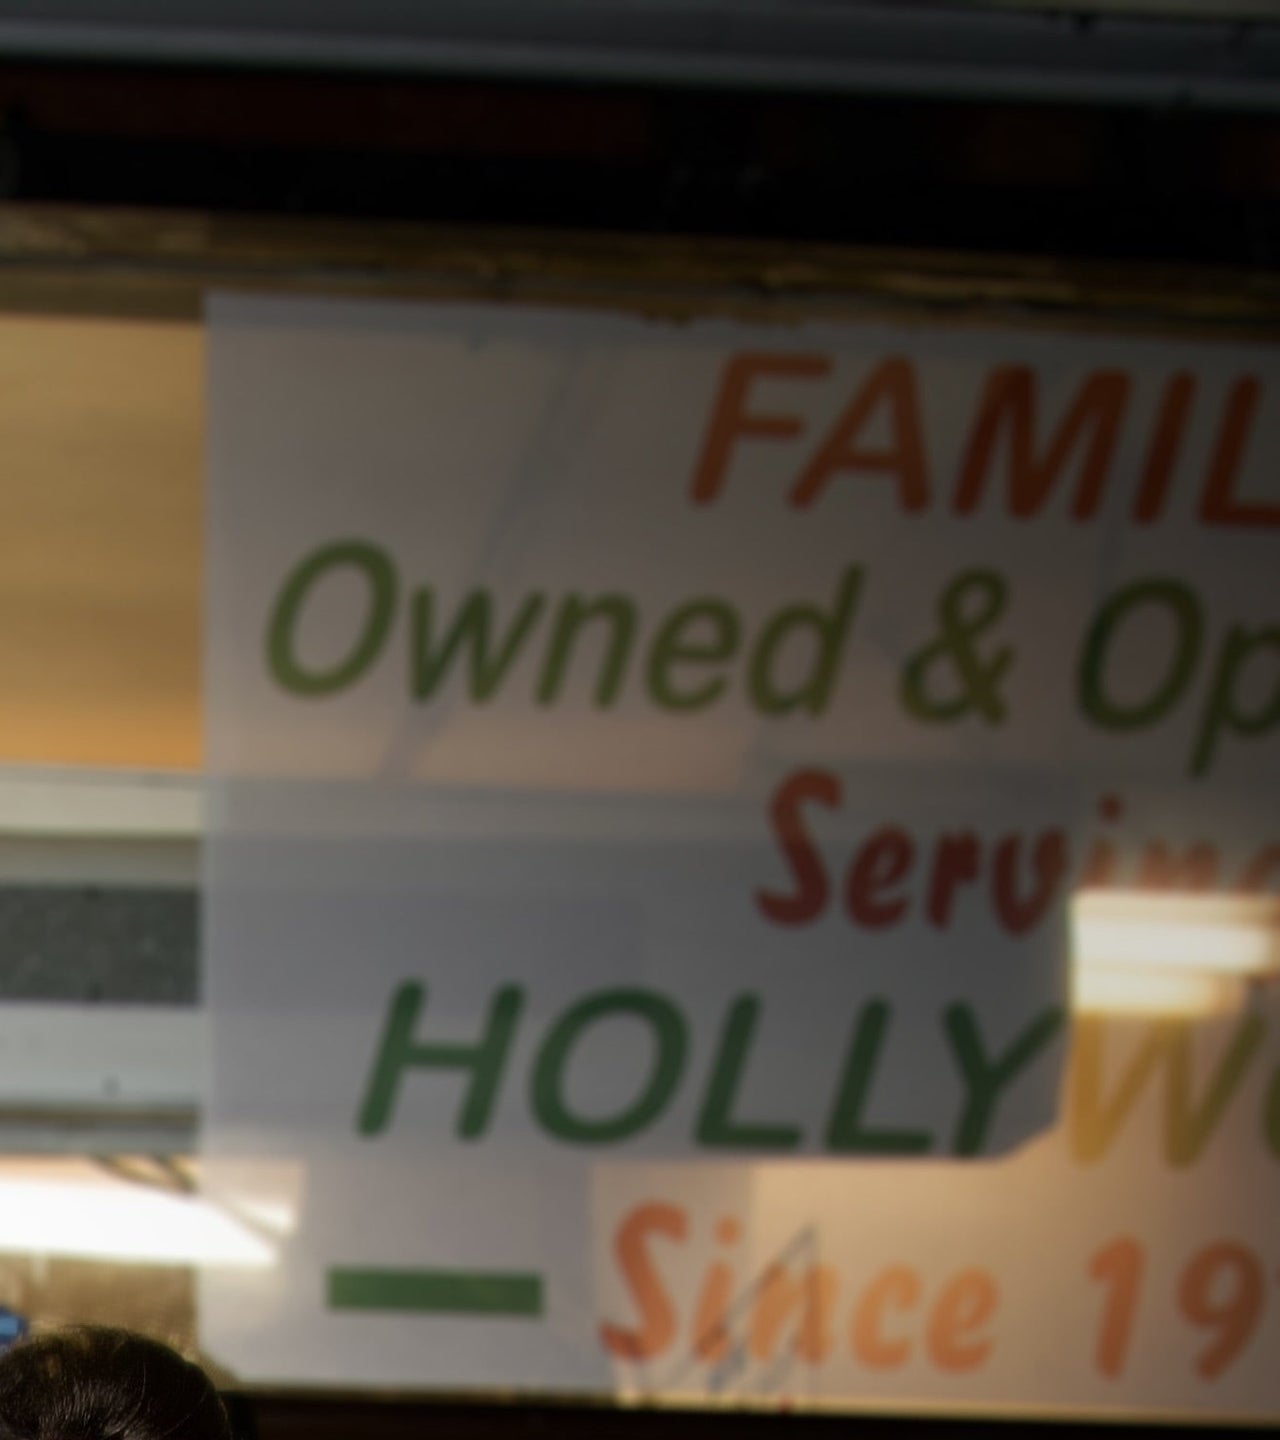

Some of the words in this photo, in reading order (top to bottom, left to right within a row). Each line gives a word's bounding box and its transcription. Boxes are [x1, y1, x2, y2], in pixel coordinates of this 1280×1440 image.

[263, 536, 864, 718] Owned
[900, 568, 1017, 727] &
[353, 978, 1280, 1170] HOLLYW
[598, 1200, 1004, 1376] Since
[1085, 1232, 1268, 1384] 19
